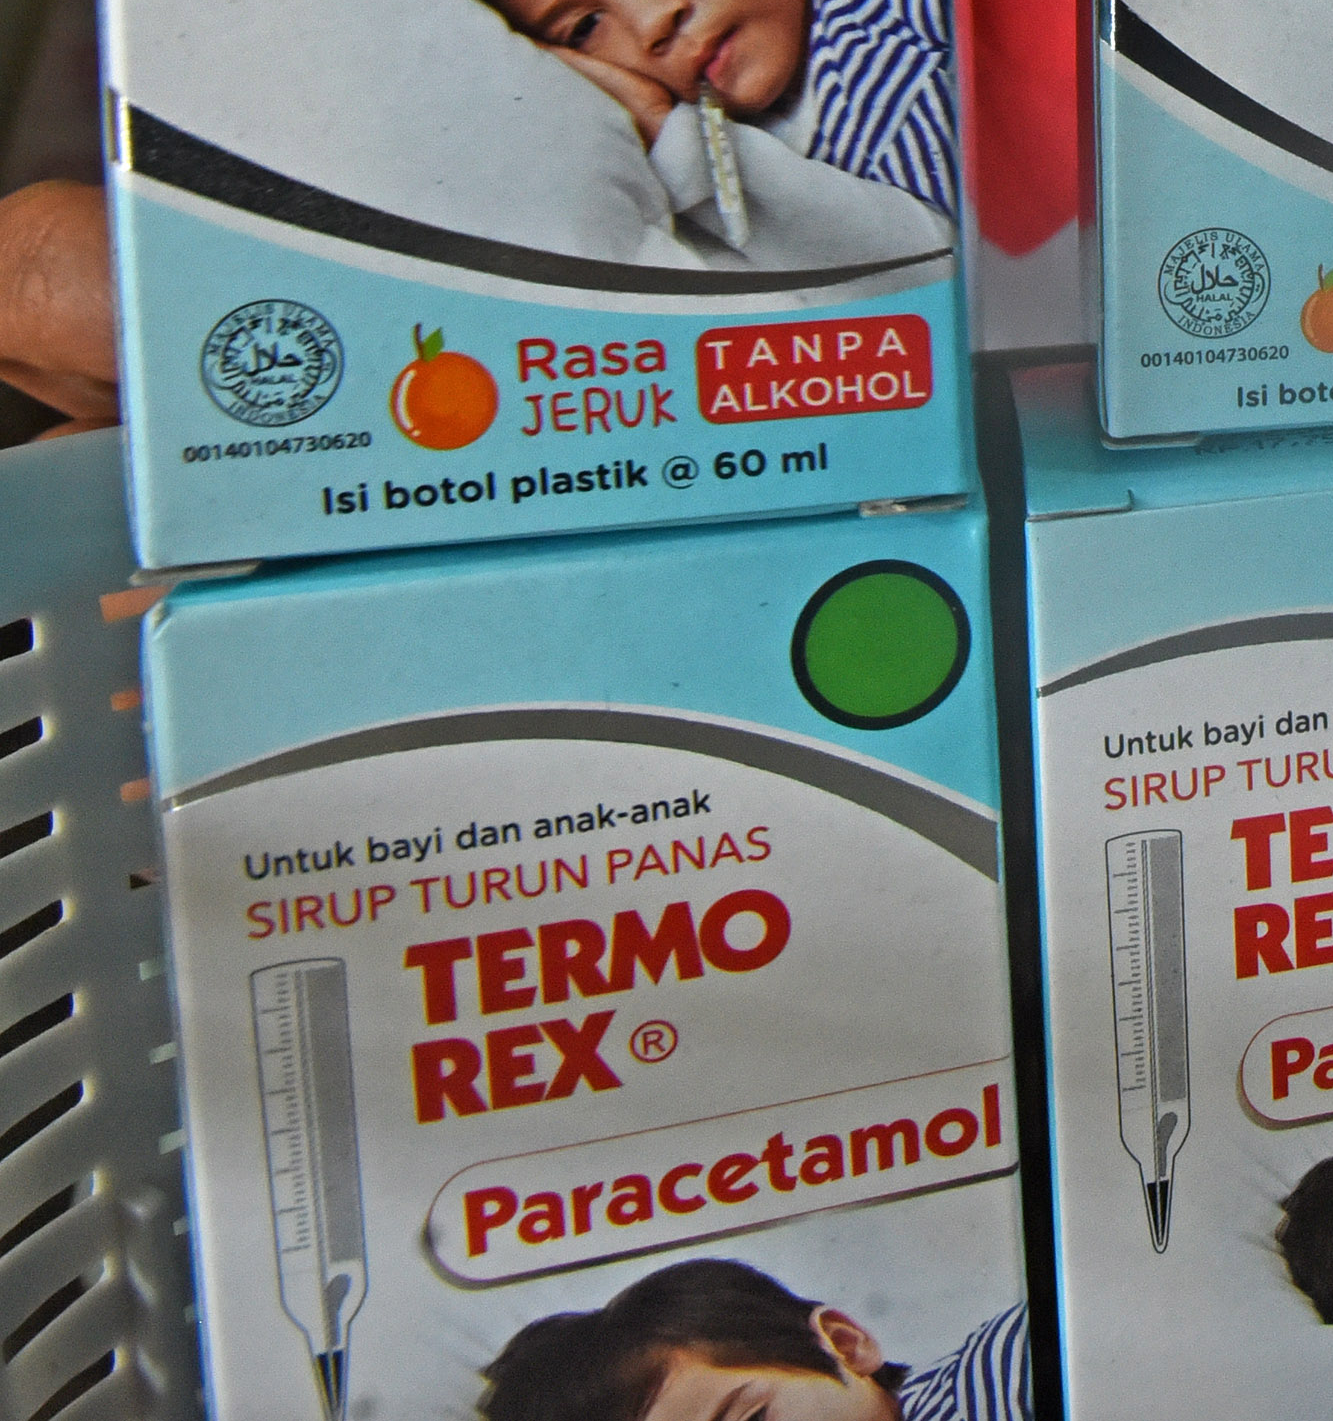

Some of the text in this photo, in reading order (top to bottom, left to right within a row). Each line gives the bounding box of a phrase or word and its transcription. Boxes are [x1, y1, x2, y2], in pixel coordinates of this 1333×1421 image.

[1163, 231, 1265, 276] MAJELIS ULAMA
[1177, 310, 1256, 336] INDONESIA
[517, 337, 666, 382] Rasa
[705, 328, 906, 369] TANPA
[1140, 345, 1289, 368] 00140104730620
[521, 382, 677, 436] JERUK
[710, 370, 926, 414] ALKOHOL
[1237, 384, 1267, 408] Isi
[323, 442, 827, 515] Isi botol plastik @ 60 ml
[1104, 725, 1193, 758] Untuk
[1204, 714, 1264, 746] bayi
[1275, 710, 1328, 735] dan
[1104, 764, 1226, 810] SIRUP
[245, 788, 711, 880] Untuk bayi dan anak-anak
[247, 825, 771, 938] SIRUP TURUN PANAS
[404, 888, 791, 1024] TERMO
[464, 1083, 1001, 1256] Paracetamol
